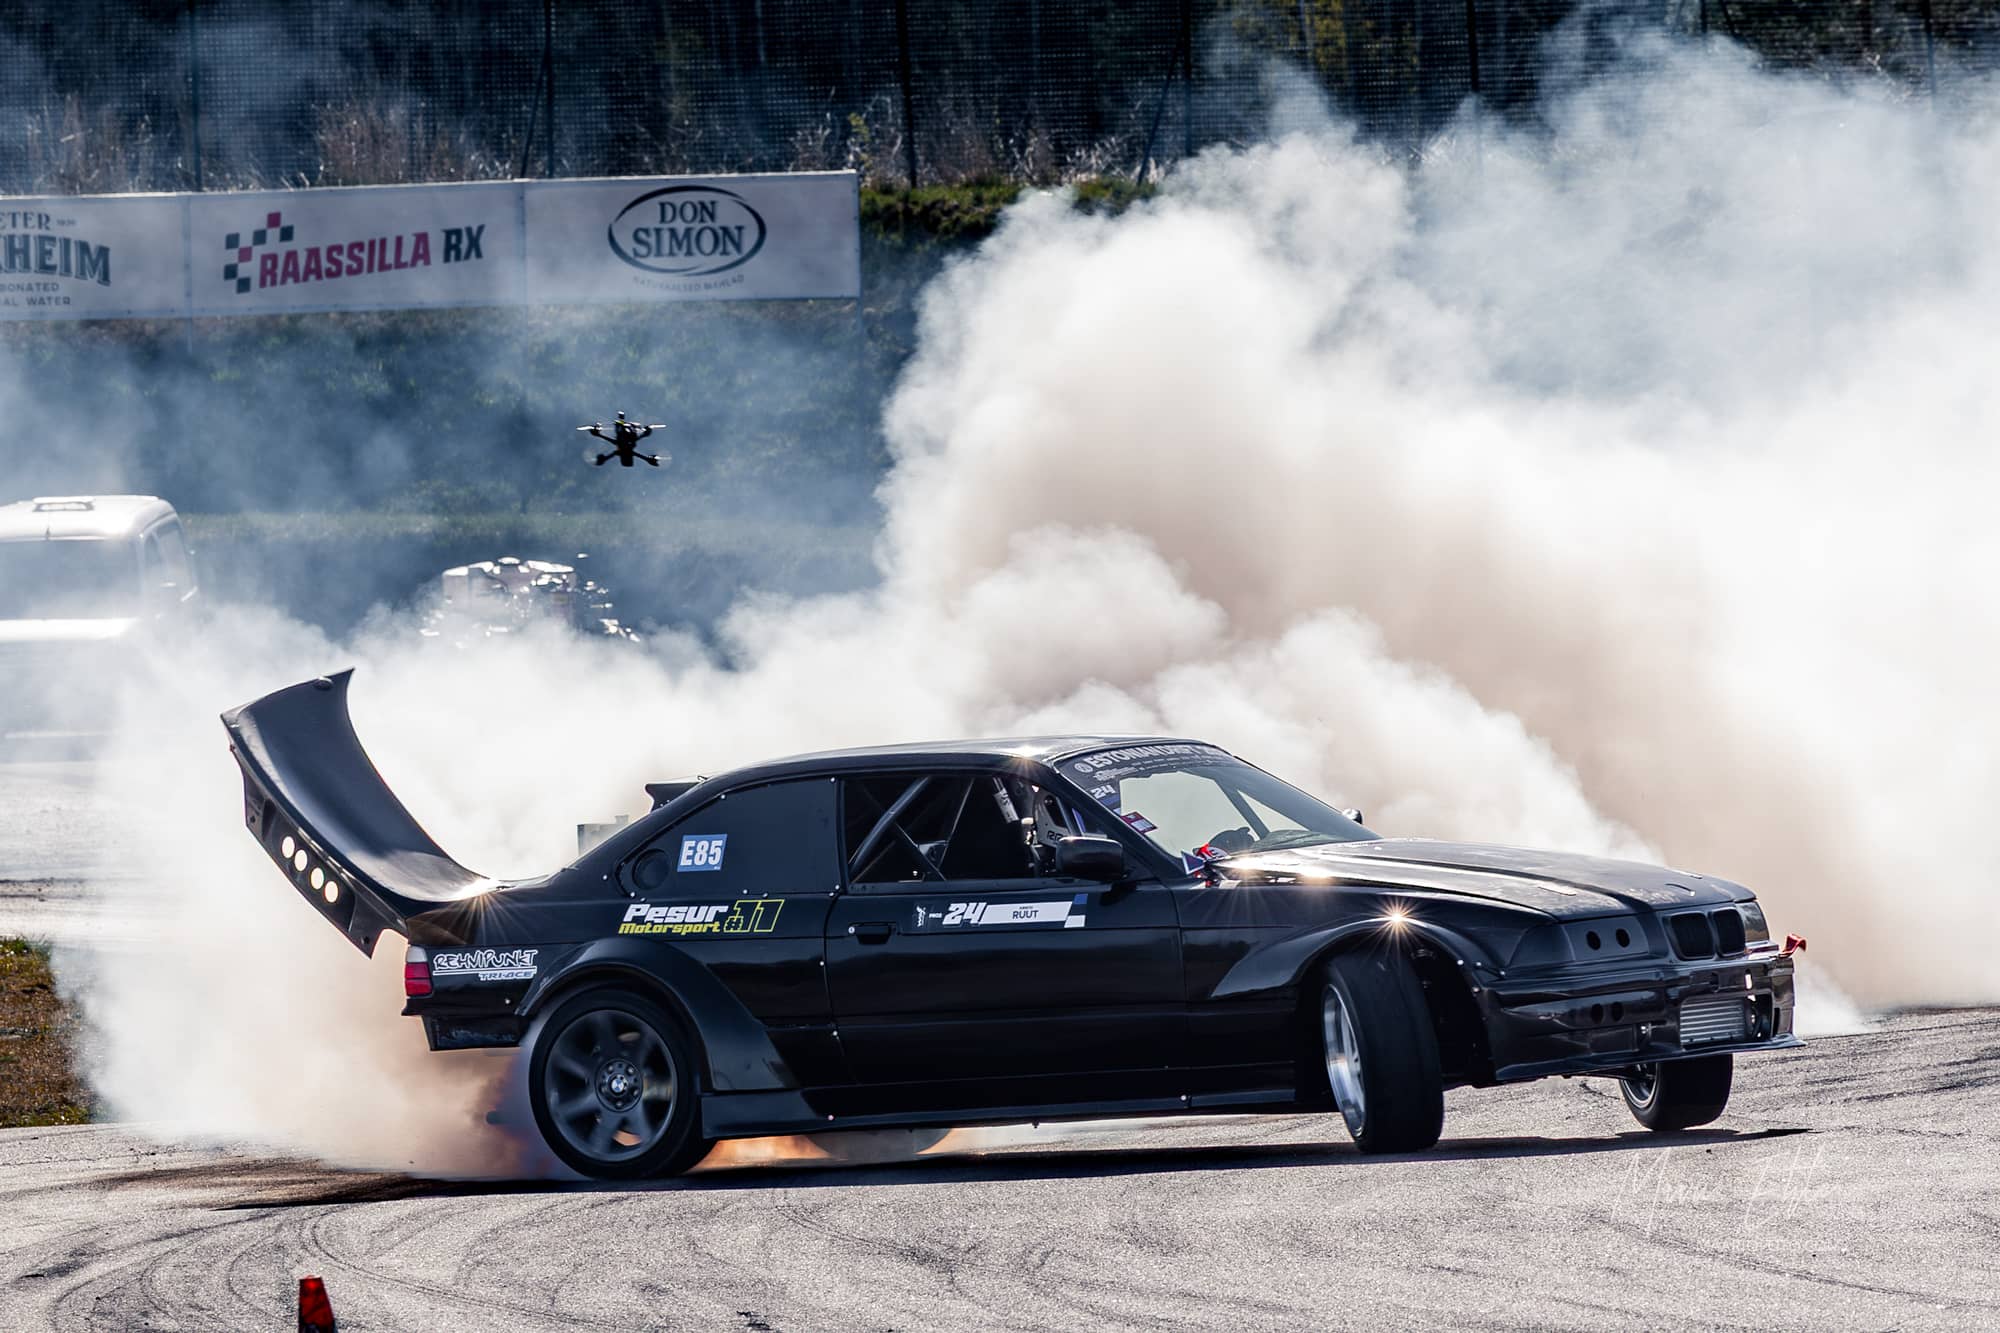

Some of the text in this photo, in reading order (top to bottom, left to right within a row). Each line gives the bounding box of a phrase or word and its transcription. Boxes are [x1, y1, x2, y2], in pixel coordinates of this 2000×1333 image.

[658, 200, 718, 224] DON
[632, 226, 745, 258] SIMON
[0, 233, 112, 287] HEIM
[259, 224, 486, 288] RAASSILLA RX
[26, 296, 71, 306] WATER
[1090, 784, 1116, 799] 24
[680, 840, 723, 867] E85
[623, 903, 729, 924] Pesur
[942, 902, 987, 926] 24
[1012, 909, 1039, 920] RUUT
[618, 921, 721, 936] Motorsport
[433, 949, 538, 970] REHVIPUNKT
